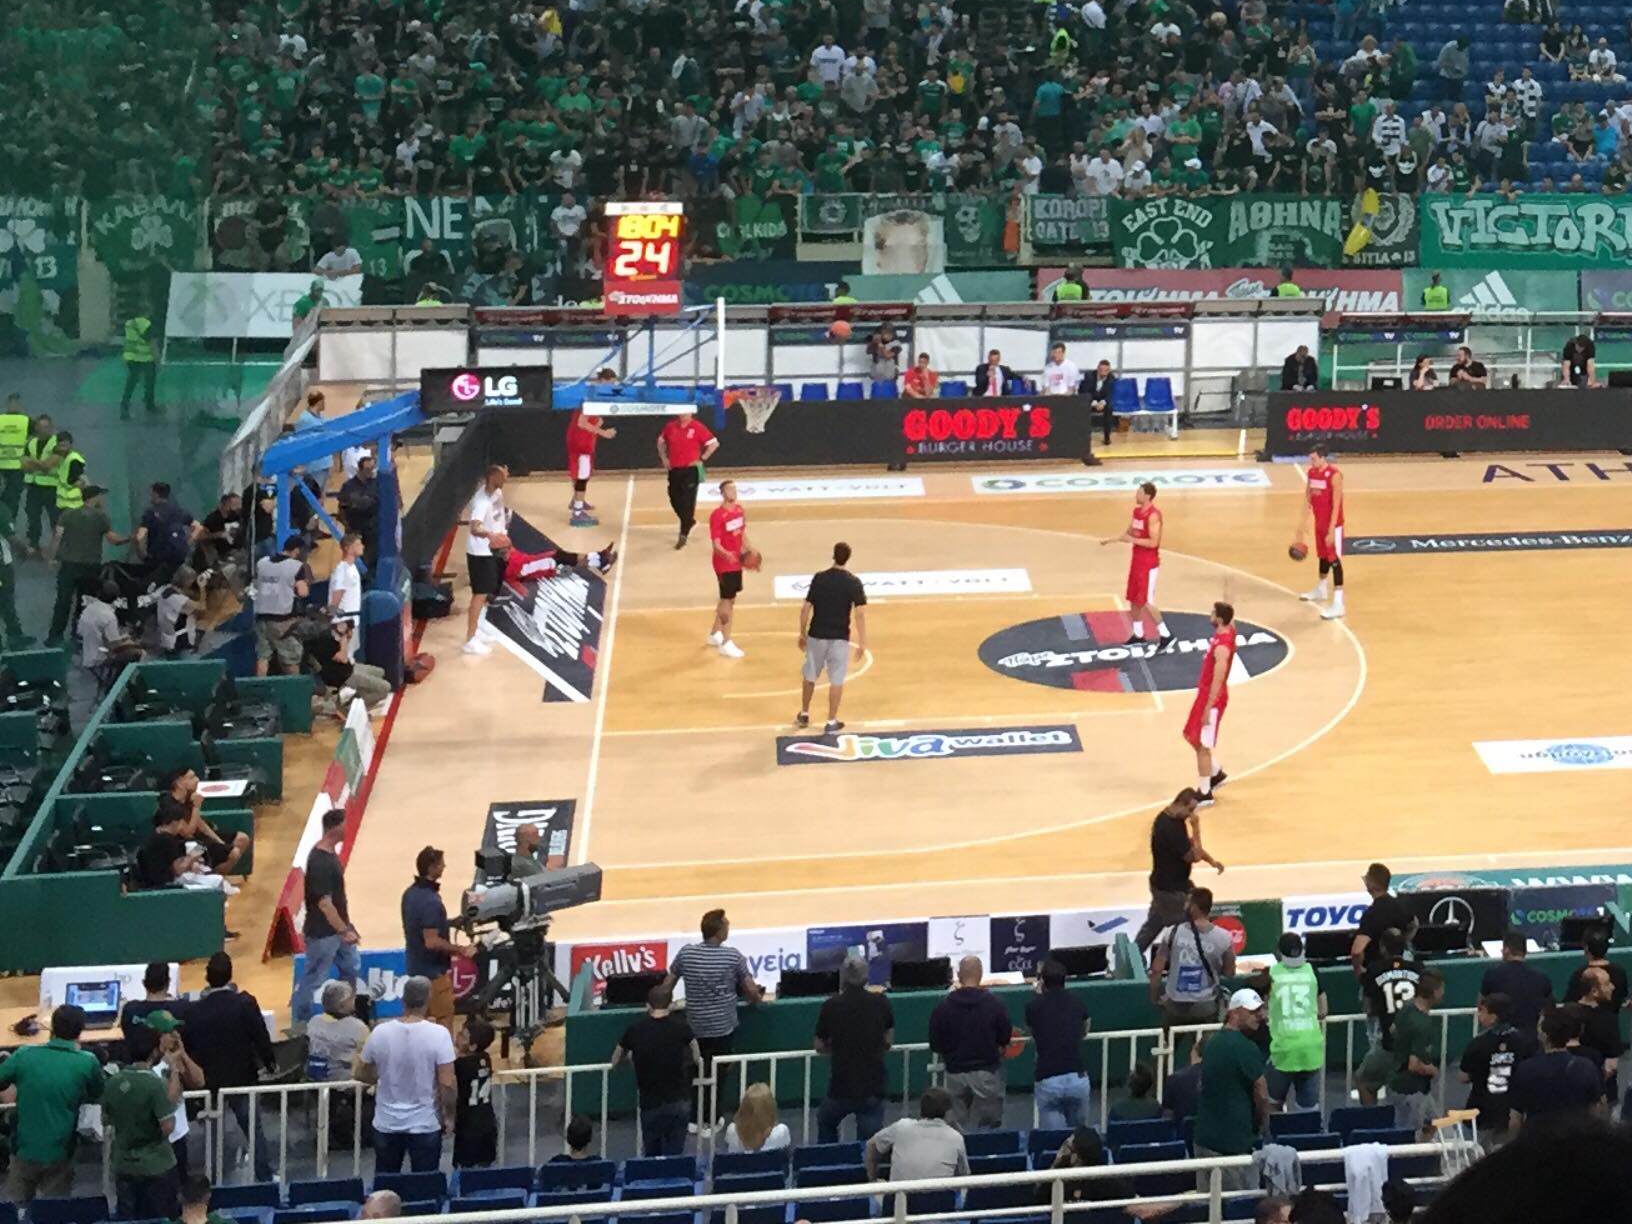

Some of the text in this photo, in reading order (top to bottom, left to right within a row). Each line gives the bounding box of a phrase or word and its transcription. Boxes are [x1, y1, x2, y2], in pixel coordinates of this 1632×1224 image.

[1034, 198, 1107, 219] KOROPI
[1123, 199, 1213, 233] EAST END
[615, 241, 671, 276] 24
[484, 375, 518, 397] LG
[904, 403, 1051, 440] GOODY'S
[1287, 403, 1380, 430] GOODY'S
[1424, 413, 1531, 430] ORDER ONLINE
[919, 439, 1034, 455] BURGER HOUSE
[1036, 473, 1262, 489] COSMOTE
[785, 730, 1073, 761] viva wallet
[1286, 904, 1369, 928] TOYO
[585, 946, 657, 981] Kelly's
[748, 946, 801, 978] γεία
[1276, 984, 1310, 1016] 13
